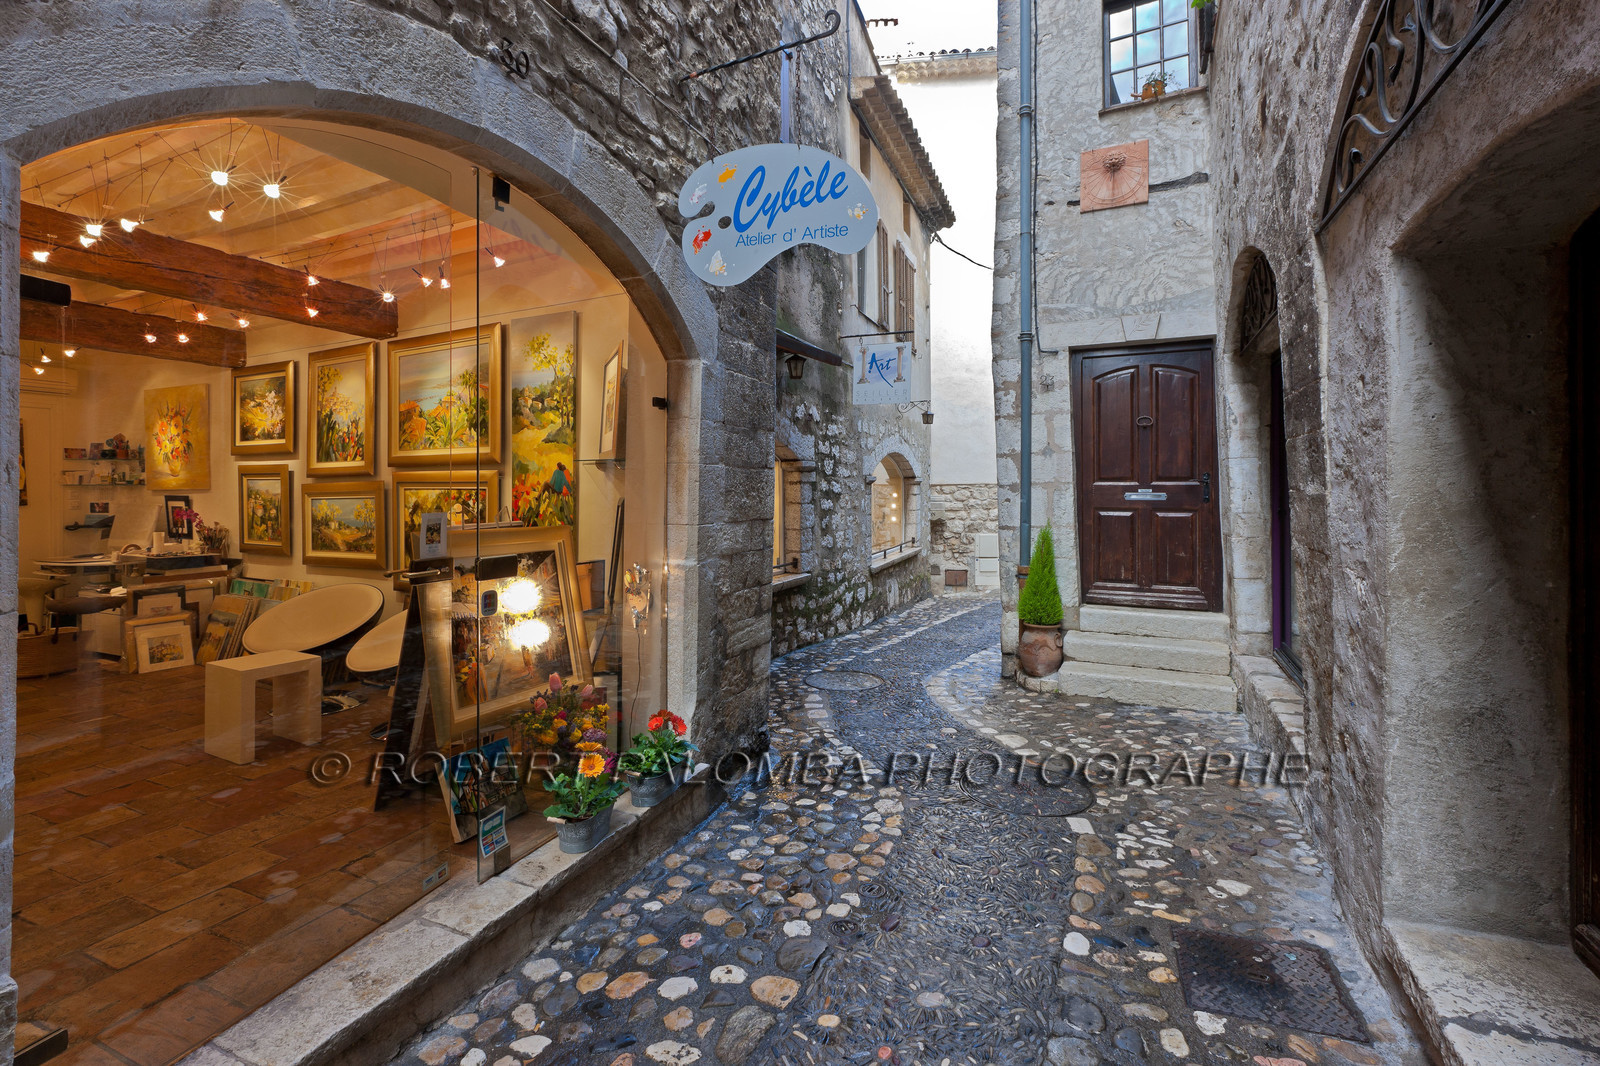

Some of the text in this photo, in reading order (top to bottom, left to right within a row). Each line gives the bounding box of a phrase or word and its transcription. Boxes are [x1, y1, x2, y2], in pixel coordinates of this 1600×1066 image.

[733, 160, 849, 233] Cybèle
[735, 223, 849, 247] Atelier d' Artiste
[867, 352, 897, 388] Art
